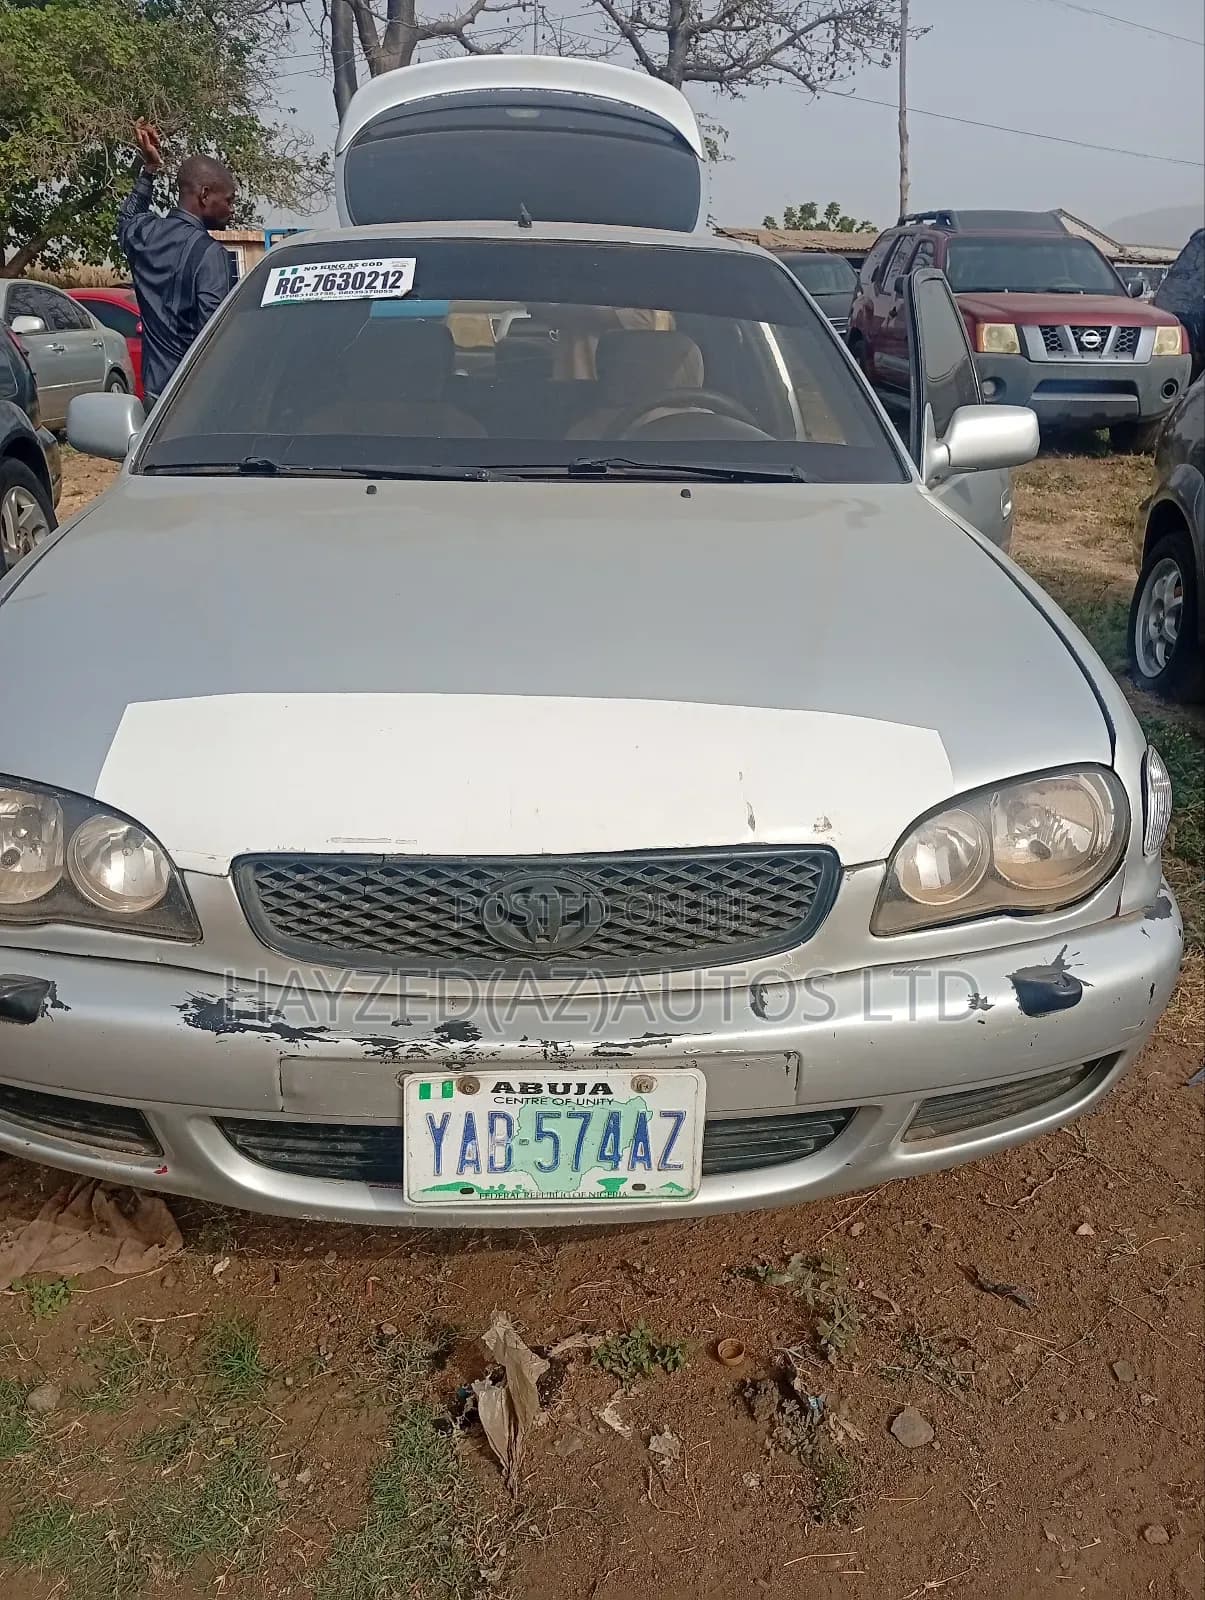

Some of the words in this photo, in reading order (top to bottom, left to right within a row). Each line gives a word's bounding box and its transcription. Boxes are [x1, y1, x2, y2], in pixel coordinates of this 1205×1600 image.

[274, 269, 404, 297] RC-7630212
[490, 1081, 613, 1095] ABUJA
[493, 1096, 548, 1106] CENTRE
[552, 1097, 572, 1106] OF
[575, 1097, 615, 1107] UNITY
[425, 1110, 687, 1177] YAB-574AZ
